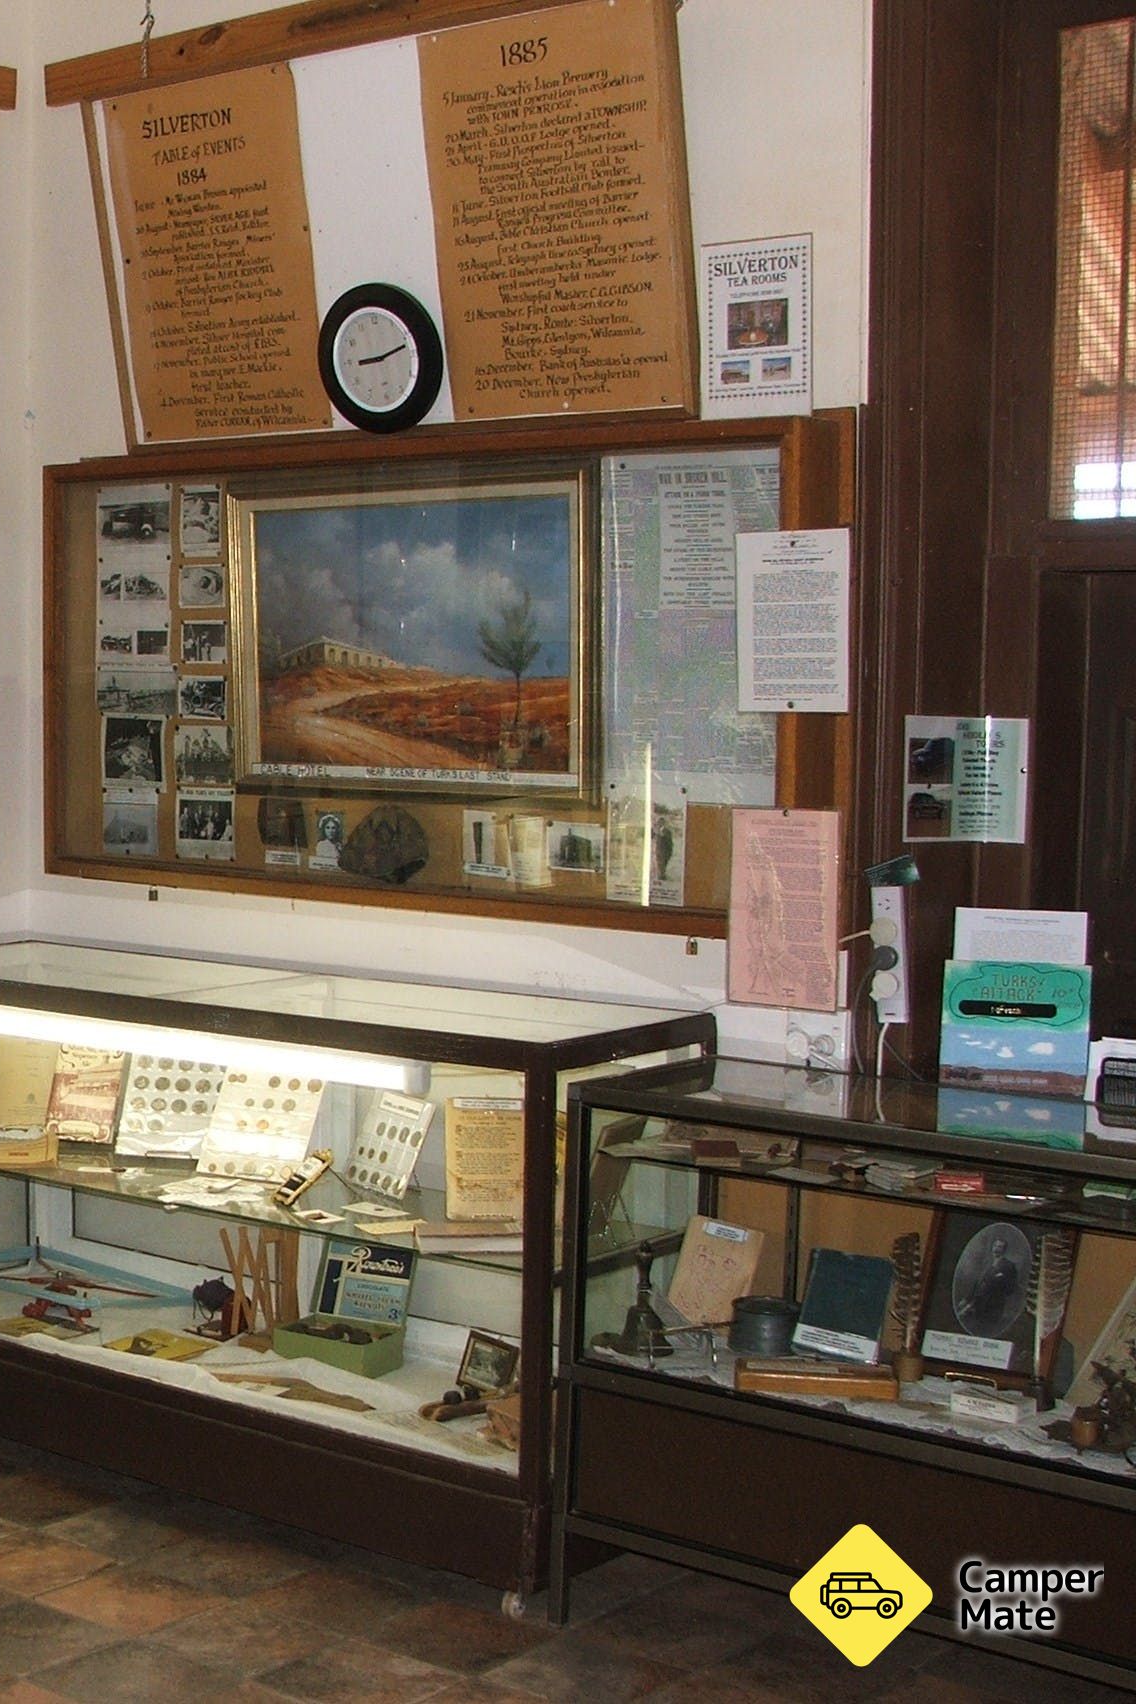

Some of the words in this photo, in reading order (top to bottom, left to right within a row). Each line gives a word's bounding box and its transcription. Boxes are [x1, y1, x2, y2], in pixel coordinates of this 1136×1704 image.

[500, 37, 550, 67] 1885
[562, 66, 610, 87] Brewery
[141, 107, 233, 139] SILVERTON
[152, 144, 190, 166] TABLE
[203, 135, 247, 157] EVENTS
[176, 167, 208, 187] 1884
[713, 254, 799, 278] SILVERTON
[727, 276, 749, 288] TEA
[750, 271, 788, 285] ROOMS
